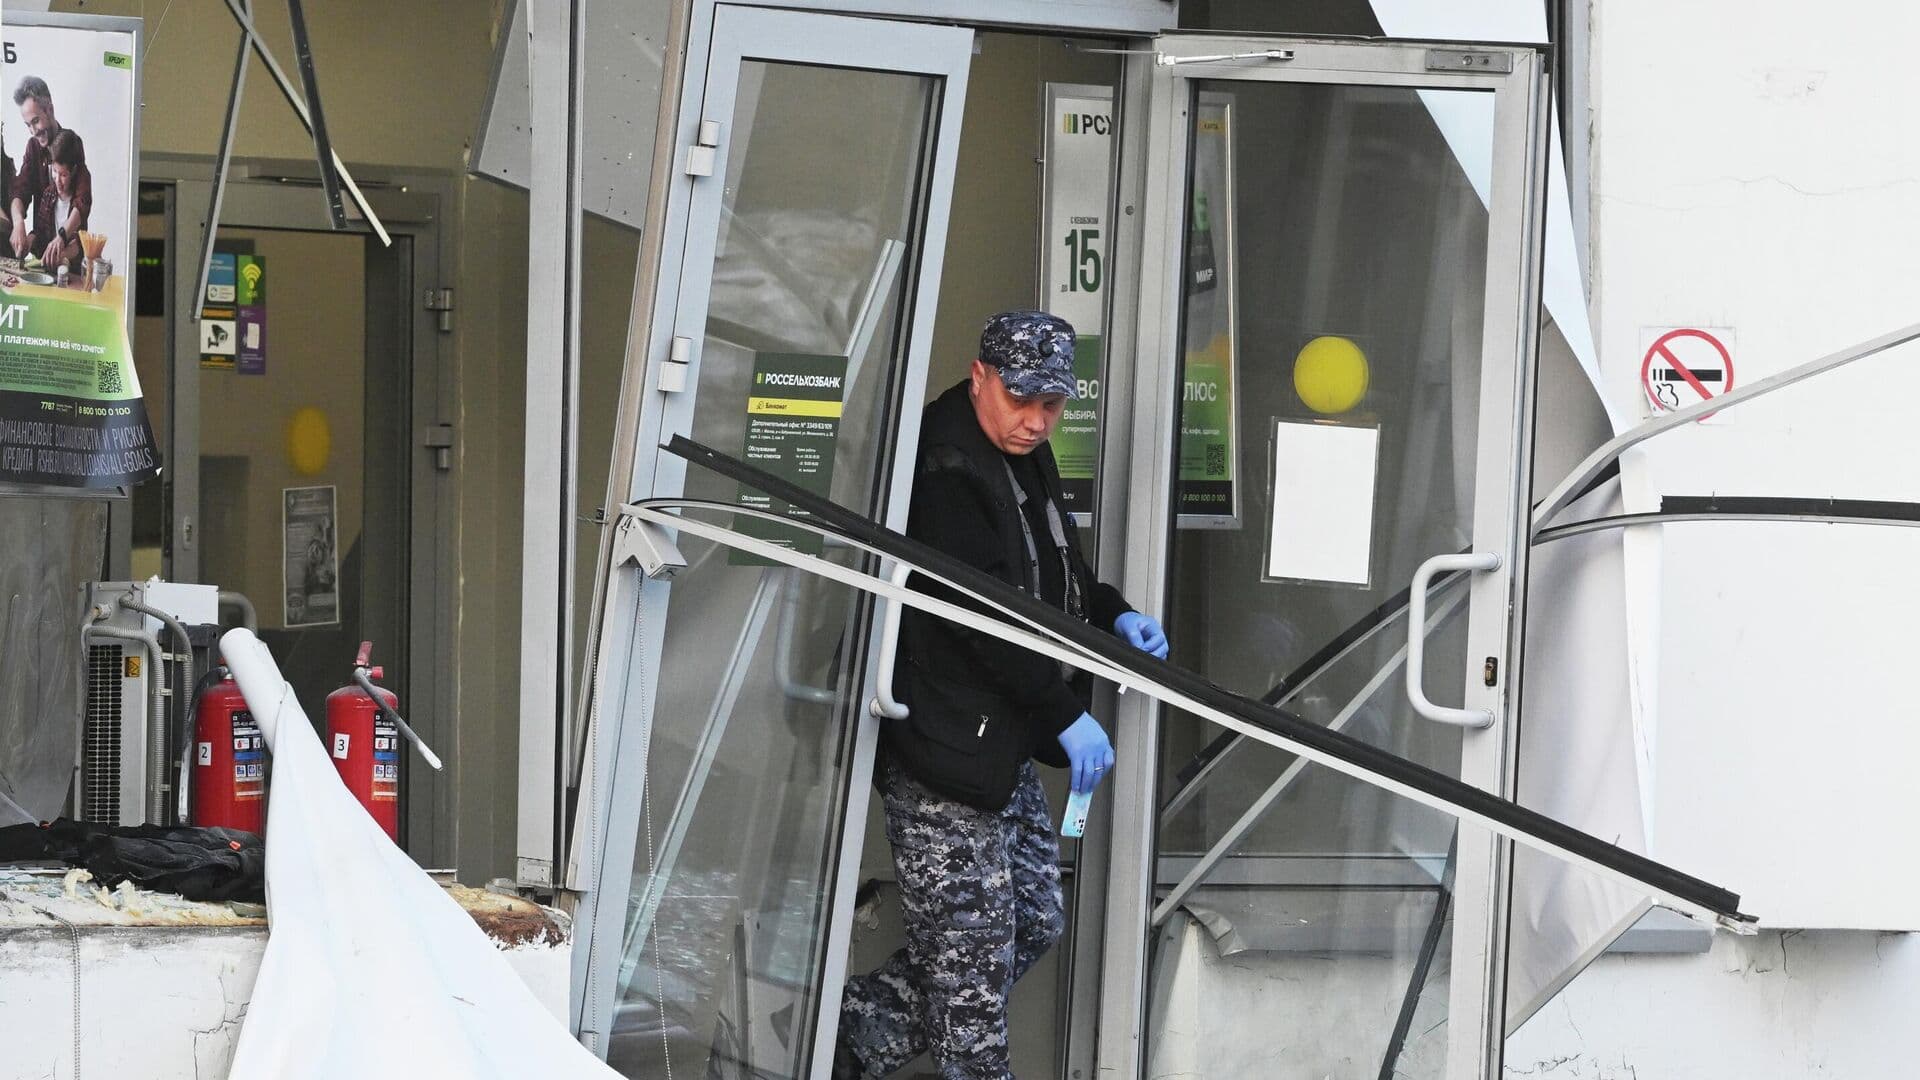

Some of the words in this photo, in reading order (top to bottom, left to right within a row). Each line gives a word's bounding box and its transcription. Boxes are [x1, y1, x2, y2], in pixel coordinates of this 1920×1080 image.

[3, 41, 17, 64] Б
[1065, 229, 1101, 293] 15
[1196, 268, 1214, 284] МИР
[0, 303, 29, 330] ИТ
[4, 335, 50, 347] платежом
[51, 339, 59, 348] на
[71, 342, 81, 351] что
[765, 372, 841, 388] РОССЕЛЬХОЗБАНК
[1183, 382, 1217, 402] ЛЮС
[83, 406, 94, 416] 800
[95, 407, 107, 416] 100
[108, 408, 114, 416] 0
[115, 407, 131, 416] 100
[1063, 409, 1097, 420] ВЫБИРА
[0, 417, 53, 447] ФИНАНСОВЫЕ
[102, 428, 110, 450] И
[112, 424, 147, 450] РИСКИ
[2, 446, 33, 475] КРЕДИТА
[201, 746, 208, 758] 2
[338, 739, 345, 752] 3
